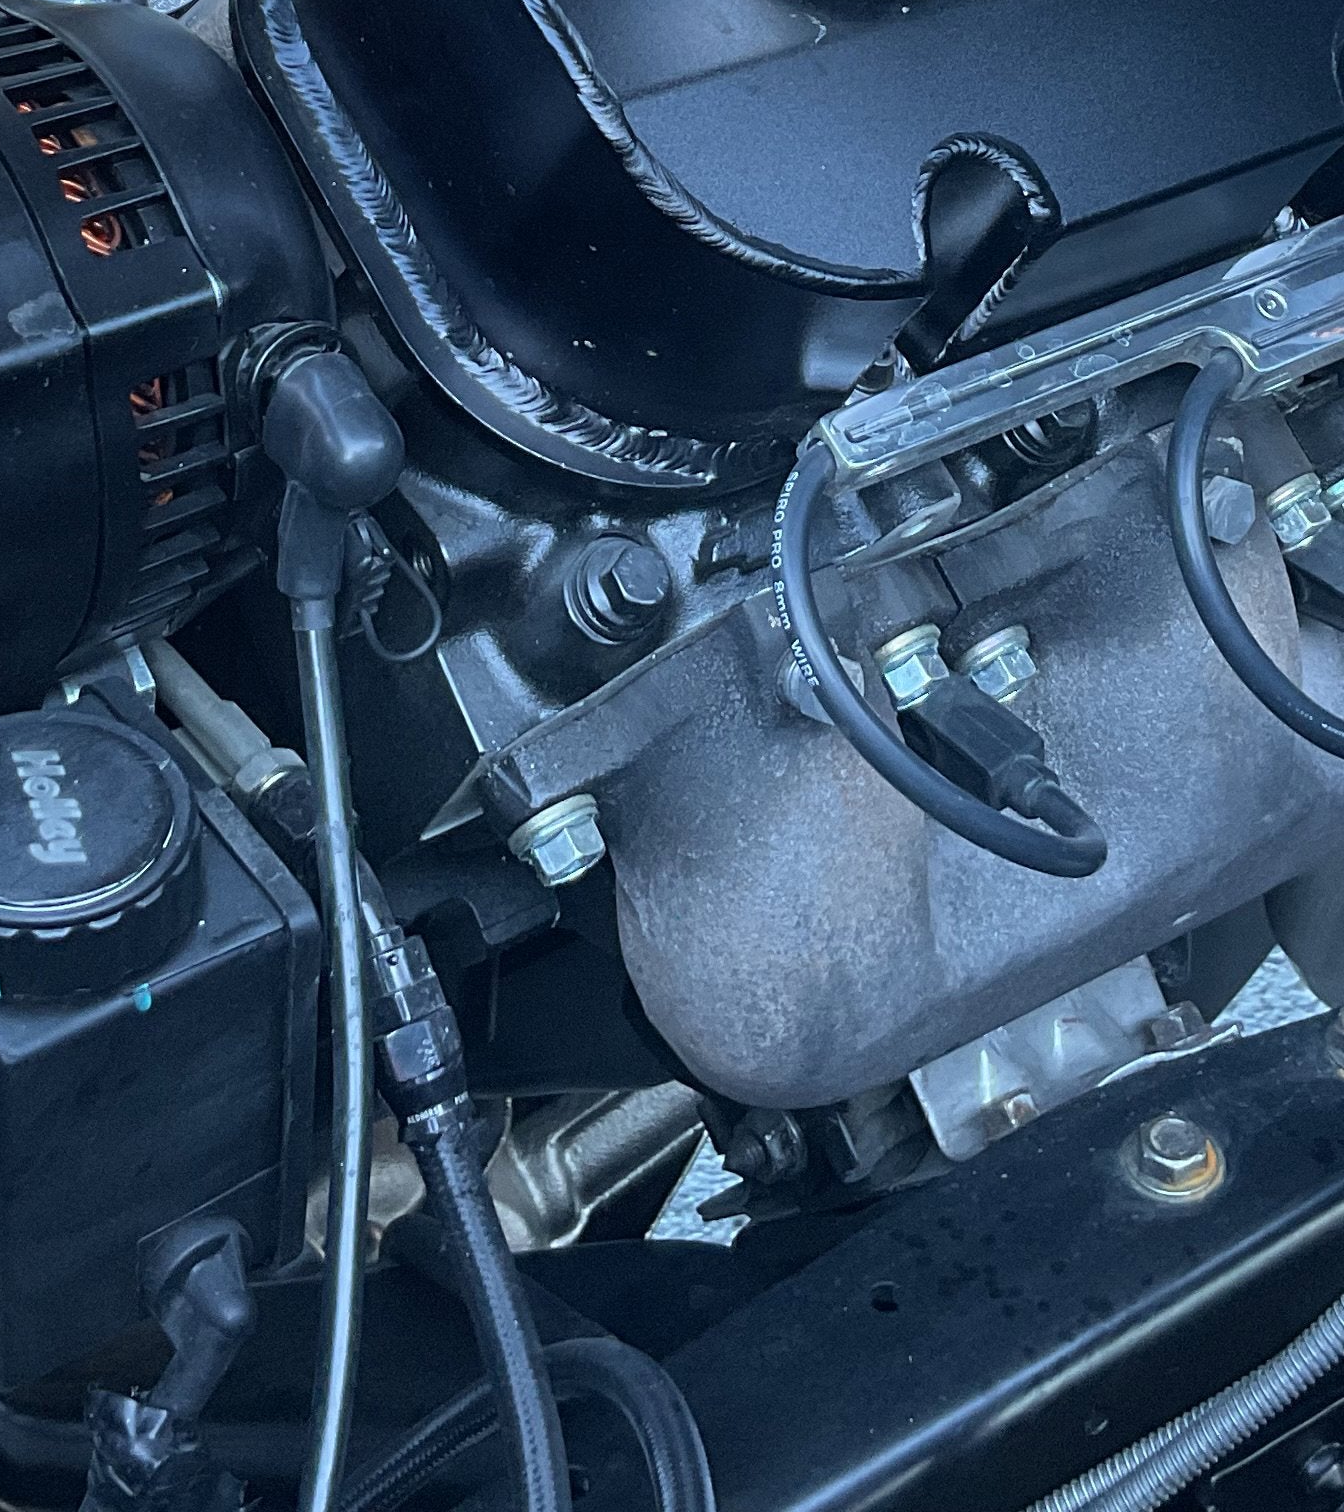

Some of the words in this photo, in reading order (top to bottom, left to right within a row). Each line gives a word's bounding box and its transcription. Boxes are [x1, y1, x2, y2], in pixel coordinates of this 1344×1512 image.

[774, 471, 800, 524] SPIRO
[771, 529, 783, 569] PRO
[773, 580, 792, 631] 8mm
[790, 638, 821, 688] WIRE
[11, 750, 88, 864] Holley
